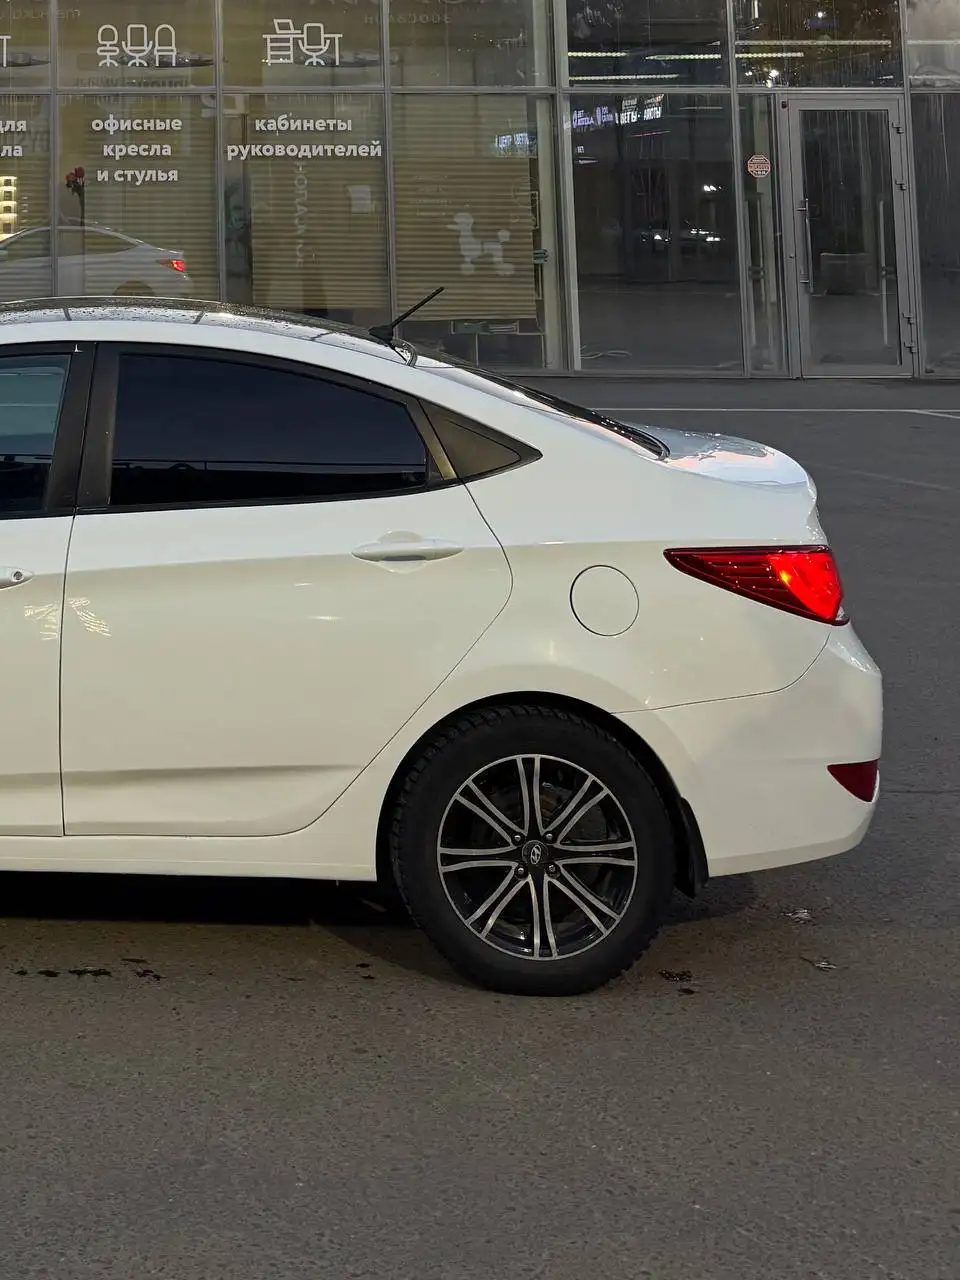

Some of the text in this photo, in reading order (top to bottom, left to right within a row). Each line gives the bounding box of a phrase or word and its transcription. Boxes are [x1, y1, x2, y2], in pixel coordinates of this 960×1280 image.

[91, 114, 182, 135] офисные
[255, 113, 352, 131] кабинеты
[103, 144, 172, 162] кресла
[227, 140, 383, 161] руководителей
[97, 169, 179, 186] и стулья
